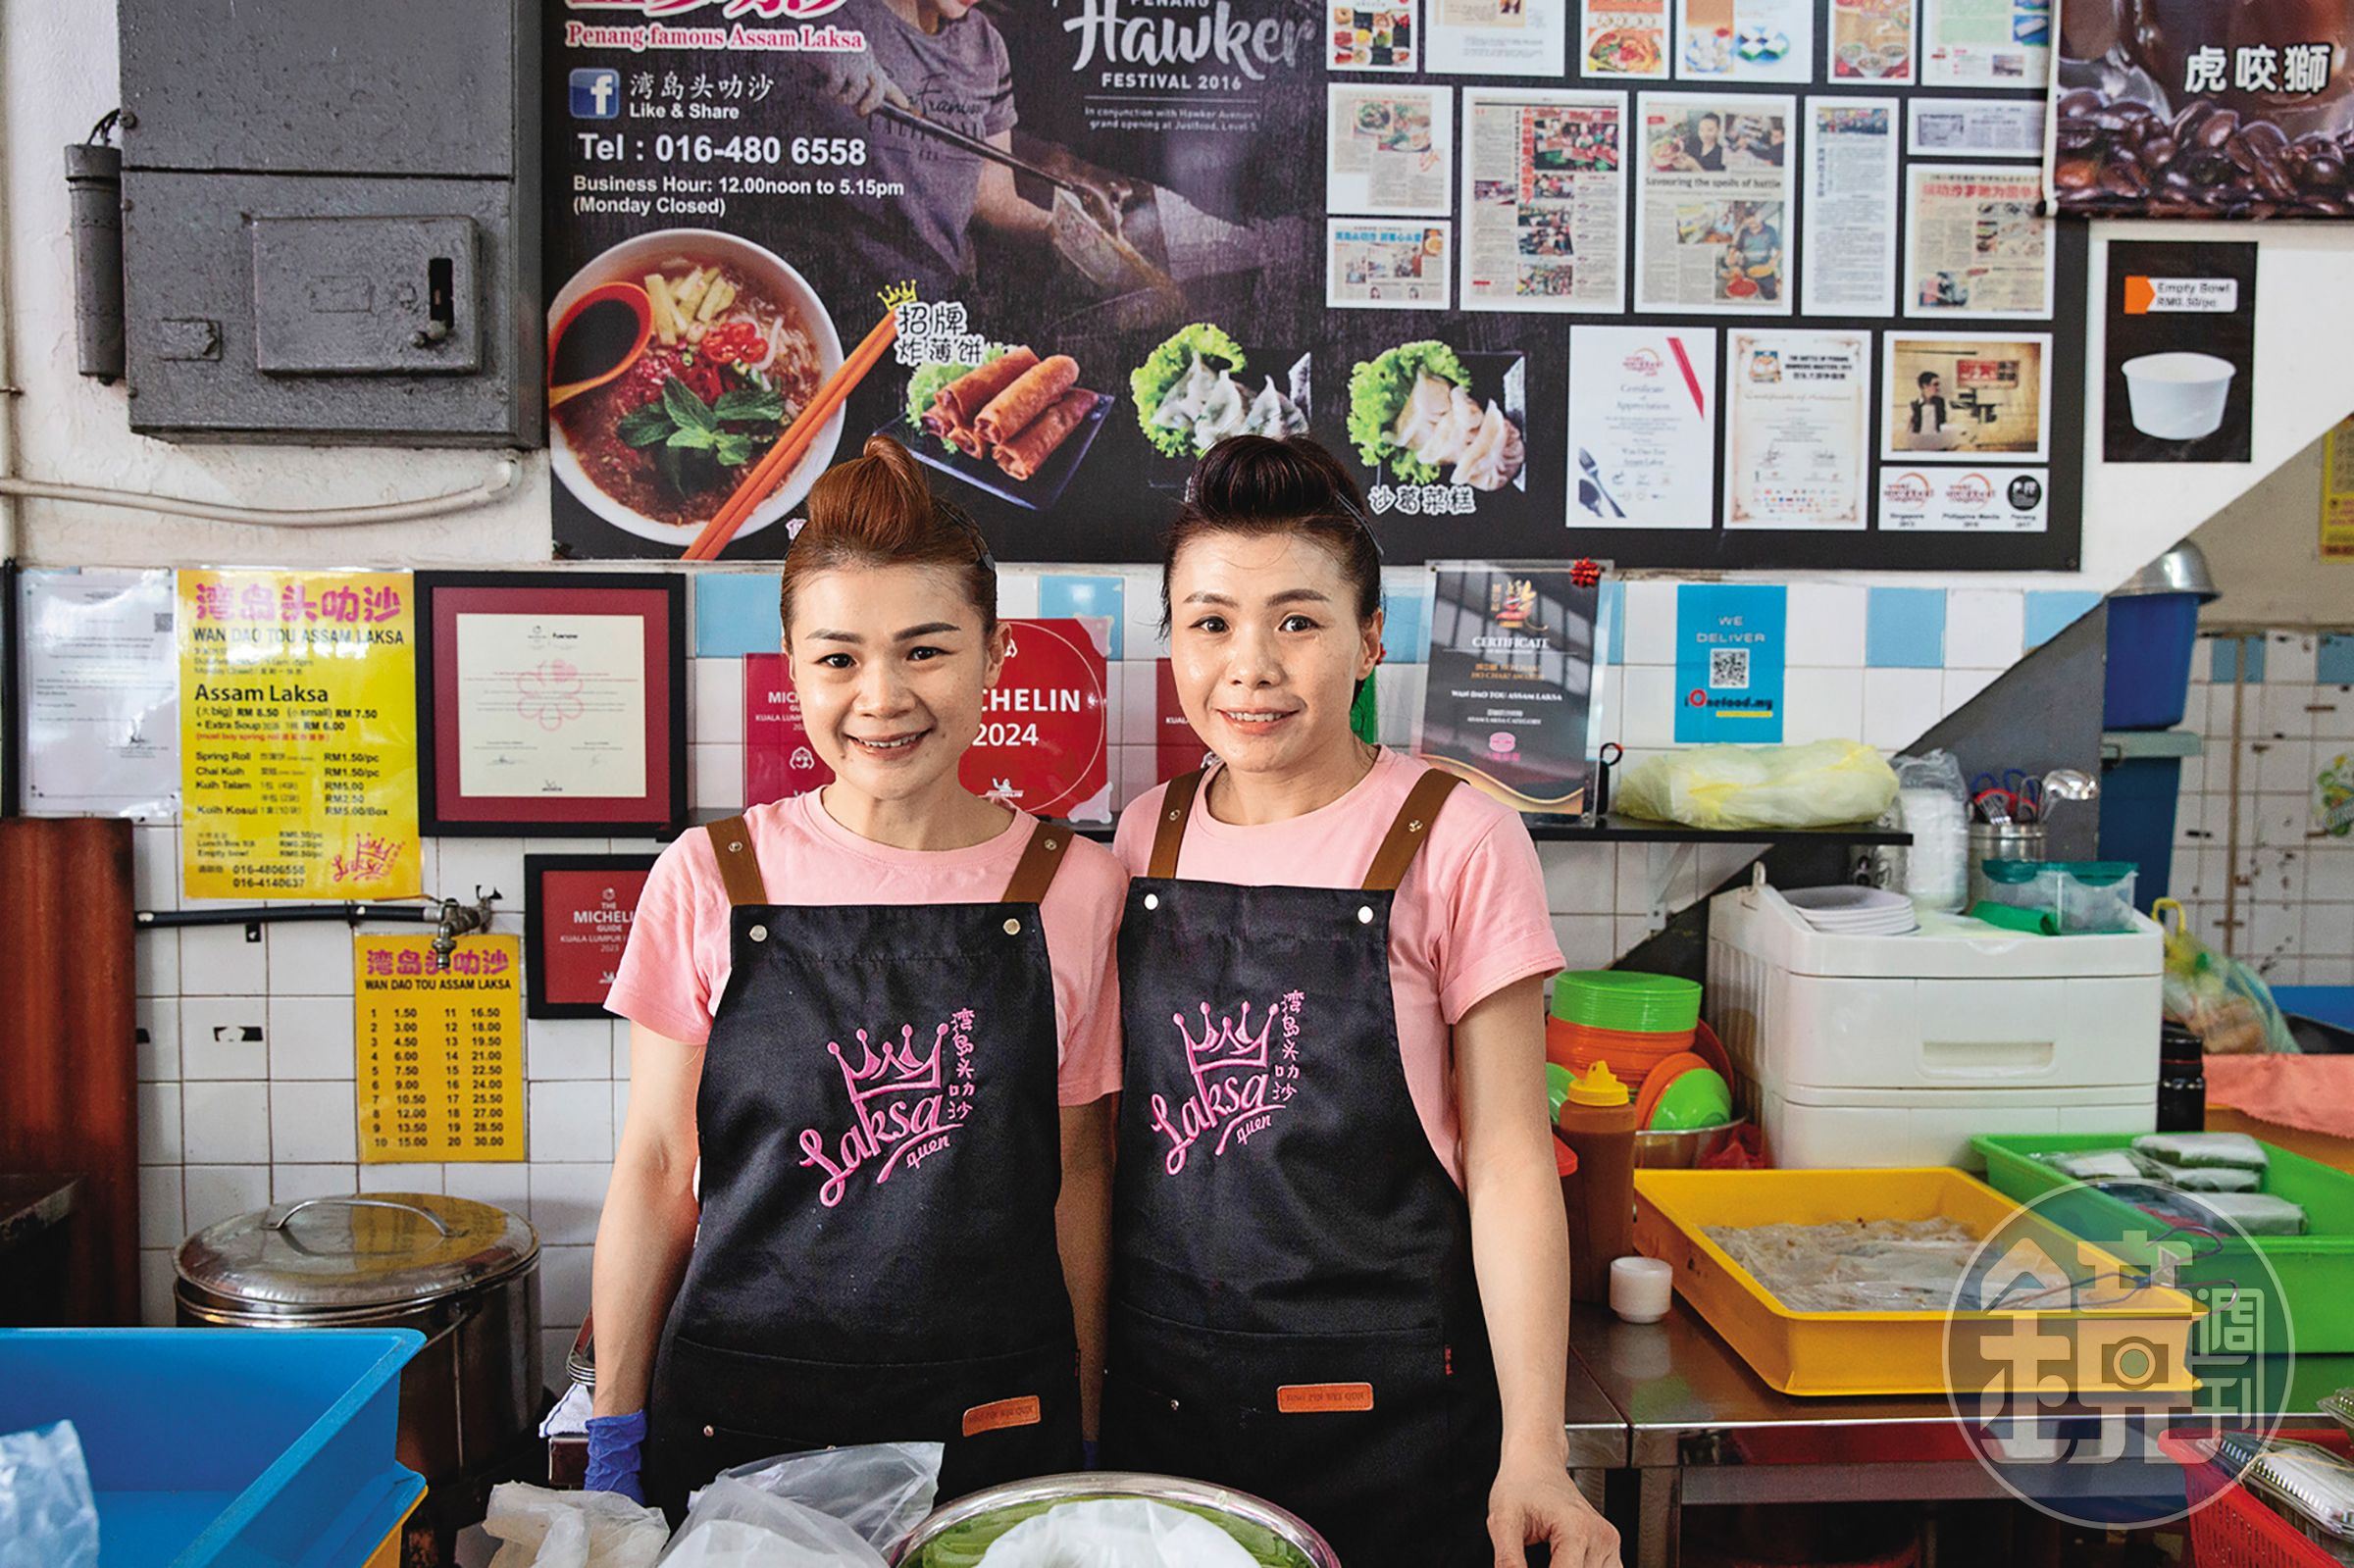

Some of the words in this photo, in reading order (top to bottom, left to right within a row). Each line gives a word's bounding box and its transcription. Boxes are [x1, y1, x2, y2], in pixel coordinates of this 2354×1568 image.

[567, 23, 645, 51] Penang
[647, 23, 727, 47] famous
[729, 24, 798, 49] Assam
[800, 25, 865, 50] Laksa
[1063, 0, 1316, 80] Hawker
[2184, 44, 2332, 93] 虎咬獅
[630, 71, 775, 100] 湾岛头叻沙
[1101, 73, 1192, 90] FESTIVAL
[1198, 76, 1243, 91] 2016
[630, 103, 667, 119] Like
[670, 104, 685, 119] &
[689, 104, 741, 120] Share
[578, 132, 624, 161] Tel
[655, 135, 782, 164] 016-480
[791, 137, 867, 166] 6558
[574, 176, 658, 193] Business
[663, 177, 713, 193] Hour:
[718, 177, 812, 195] 12.00noon
[816, 180, 836, 195] to
[840, 179, 904, 198] 5.15pm
[574, 197, 650, 216] (Monday
[656, 198, 726, 217] Closed)
[2158, 282, 2195, 294] Empty
[2200, 283, 2230, 293] Bowl
[897, 304, 968, 335] 招牌
[897, 337, 984, 364] 炸薄饼
[1718, 616, 1743, 626] WE
[193, 628, 226, 642] WAN
[231, 628, 261, 643] DAO
[267, 628, 296, 643] TOU
[301, 628, 352, 644] ASSAM
[356, 629, 404, 644] LAKSA
[1471, 636, 1550, 648] CERTIFICATE
[1696, 632, 1766, 643] DELIVER
[194, 683, 264, 702] Assam
[270, 684, 329, 702] Laksa
[205, 721, 231, 730] Extra
[234, 722, 261, 732] Soup
[972, 724, 1039, 746] 2024
[195, 752, 230, 763] Spring
[231, 752, 251, 761] Roll
[325, 753, 380, 764] RM1.50/pc
[325, 768, 381, 779] RM1.50/pc
[195, 782, 221, 790] Kuih
[365, 980, 387, 990] WAN
[391, 980, 412, 990] DAO
[416, 980, 435, 990] TOU
[439, 980, 475, 990] ASSAM
[478, 980, 511, 990] LAKSA
[371, 1009, 377, 1018] 1
[394, 1009, 417, 1018] 1.50
[445, 1008, 456, 1017] 11
[471, 1008, 500, 1017] 16.50
[371, 1023, 378, 1032] 2
[394, 1023, 418, 1032] 3.00
[445, 1023, 457, 1032] 12
[472, 1023, 500, 1032] 18.00
[371, 1037, 378, 1046] 3
[394, 1037, 418, 1046] 4.50
[445, 1037, 457, 1046] 13
[472, 1037, 501, 1046] 19.50
[1272, 989, 1305, 1102] 湾岛头叻沙
[372, 1052, 379, 1061] 4
[395, 1052, 418, 1061] 6.00
[446, 1051, 458, 1060] 14
[472, 1051, 501, 1060] 21.00
[947, 1008, 976, 1120] 湾岛头叻沙
[372, 1066, 379, 1075] 5
[395, 1066, 419, 1075] 7.50
[446, 1066, 458, 1075] 15
[473, 1066, 501, 1075] 22.50
[372, 1081, 379, 1089] 6
[395, 1081, 419, 1089] 9.00
[446, 1080, 459, 1089] 16
[473, 1080, 502, 1089] 24.00
[373, 1095, 380, 1104] 7
[396, 1095, 426, 1104] 10.50
[447, 1094, 460, 1103] 17
[474, 1094, 502, 1103] 25.50
[373, 1109, 380, 1118] 8
[397, 1109, 426, 1118] 12.00
[447, 1109, 460, 1118] 18
[474, 1109, 503, 1118] 27.00
[373, 1124, 381, 1133] 9
[397, 1124, 427, 1133] 13.50
[447, 1123, 461, 1133] 19
[474, 1123, 503, 1133] 28.50
[1151, 1074, 1270, 1176] Laksa
[1236, 1115, 1272, 1145] quen
[375, 1138, 387, 1147] 10
[398, 1138, 427, 1147] 15.00
[448, 1138, 461, 1146] 20
[475, 1138, 504, 1146] 30.00
[799, 1094, 944, 1208] Laksa
[906, 1135, 950, 1170] quen
